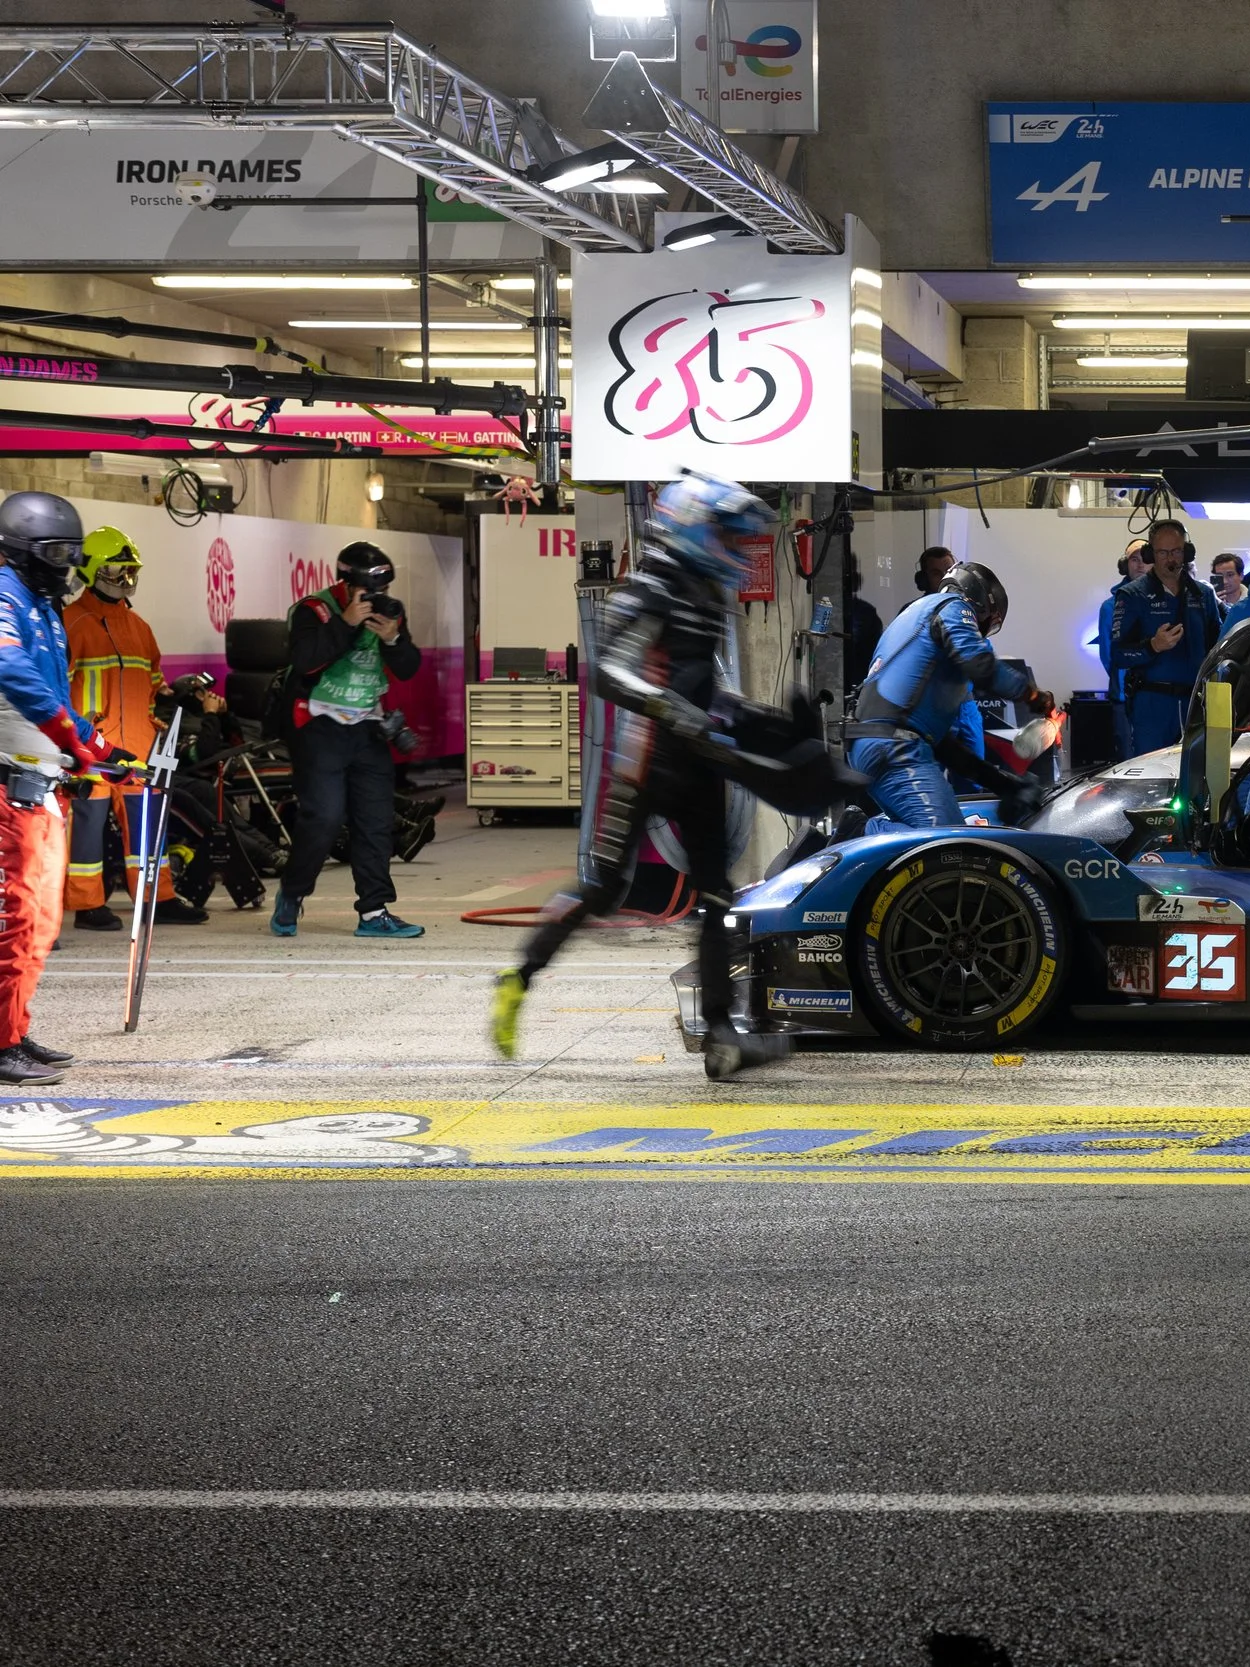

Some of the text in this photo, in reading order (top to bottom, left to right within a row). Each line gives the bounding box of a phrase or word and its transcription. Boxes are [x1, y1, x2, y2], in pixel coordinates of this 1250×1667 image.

[1077, 119, 1105, 134] 24h
[116, 160, 188, 183] IRON
[1149, 168, 1243, 189] ALPINE
[130, 195, 182, 206] Porsche
[19, 358, 99, 383] DAMES
[604, 291, 825, 444] 85
[325, 431, 371, 443] MARTIN
[457, 431, 520, 443] M. GATTIN
[1064, 859, 1121, 879] GCR
[1153, 898, 1185, 914] 24h
[806, 913, 843, 923] Sabelt
[1020, 881, 1056, 952] MICHELIN
[798, 952, 843, 963] BAHCO
[1164, 932, 1238, 992] 35
[864, 944, 898, 1014] MICHELIN
[787, 997, 851, 1007] MICHELIN
